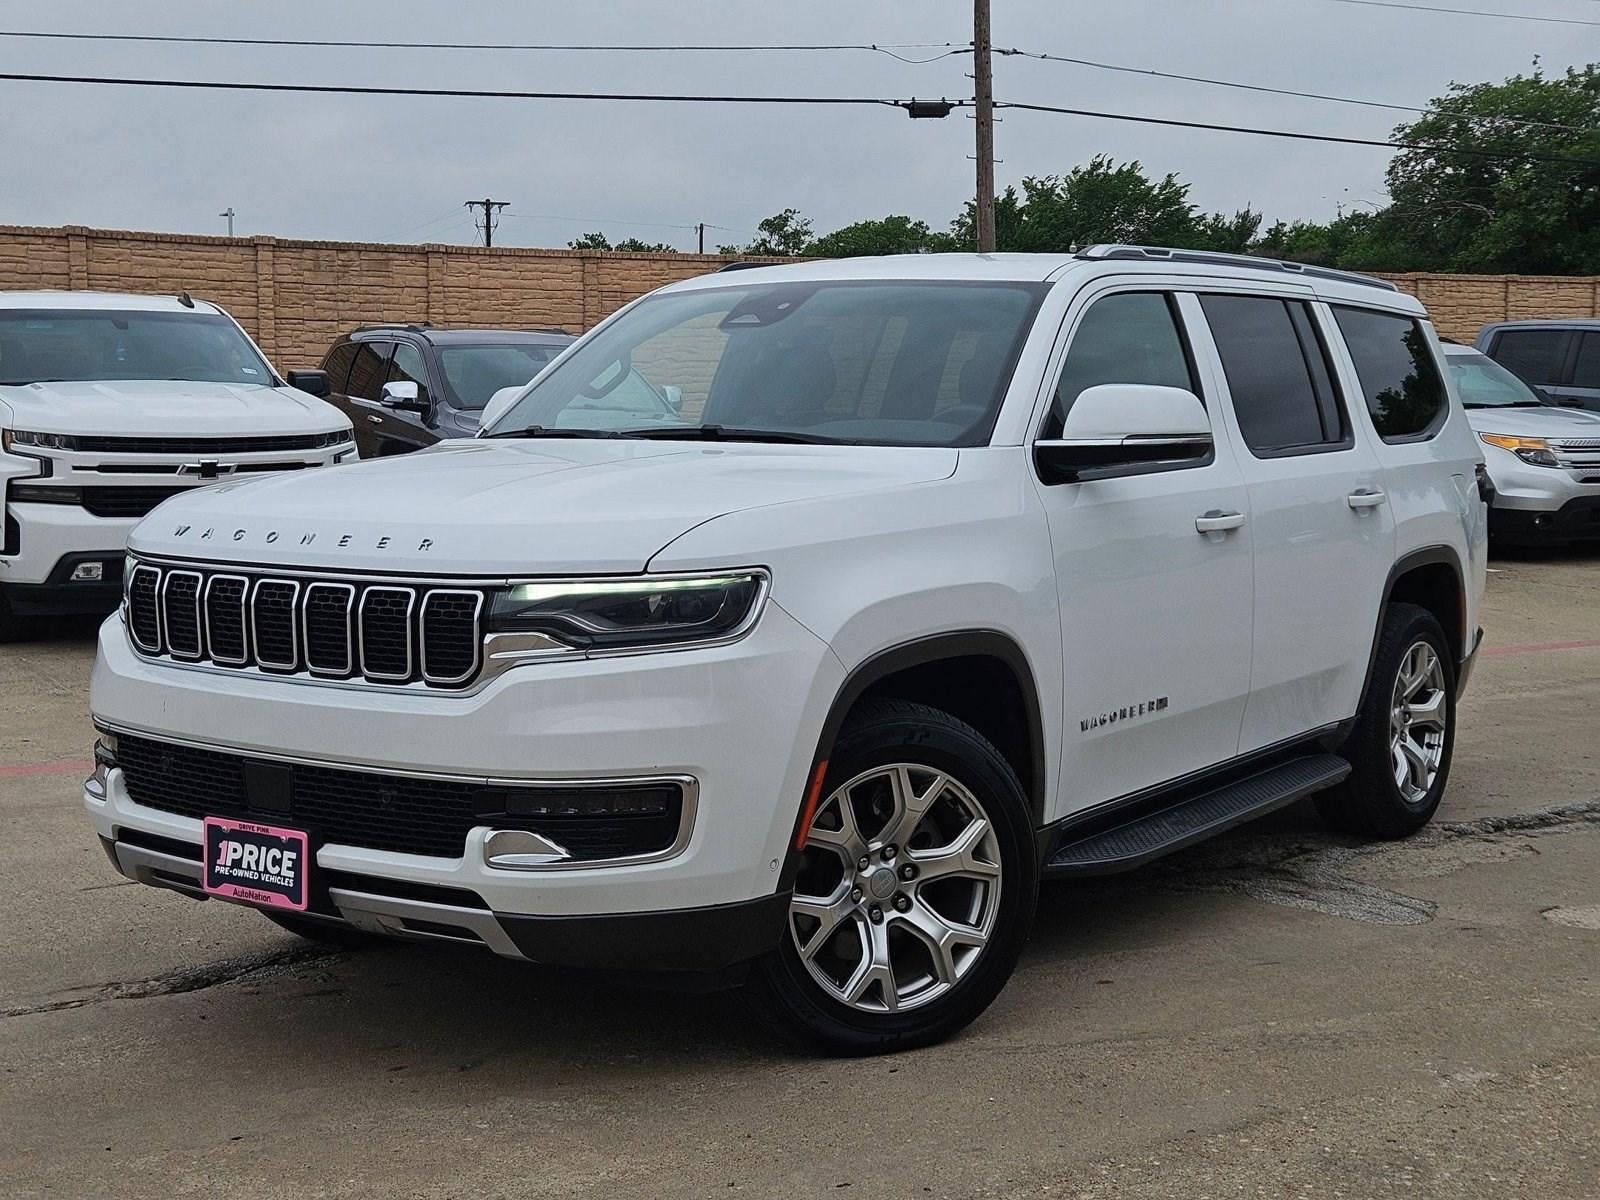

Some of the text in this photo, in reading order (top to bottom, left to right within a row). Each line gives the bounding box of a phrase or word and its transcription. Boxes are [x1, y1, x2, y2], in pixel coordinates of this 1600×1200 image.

[174, 525, 434, 551] WAGONEER
[1080, 701, 1155, 732] WAGONEER
[238, 823, 270, 834] DRIVE PINK
[216, 840, 297, 878] 1PRICE
[215, 865, 294, 887] PRE-OWNED VEHICLES
[232, 888, 272, 903] AutoNation
